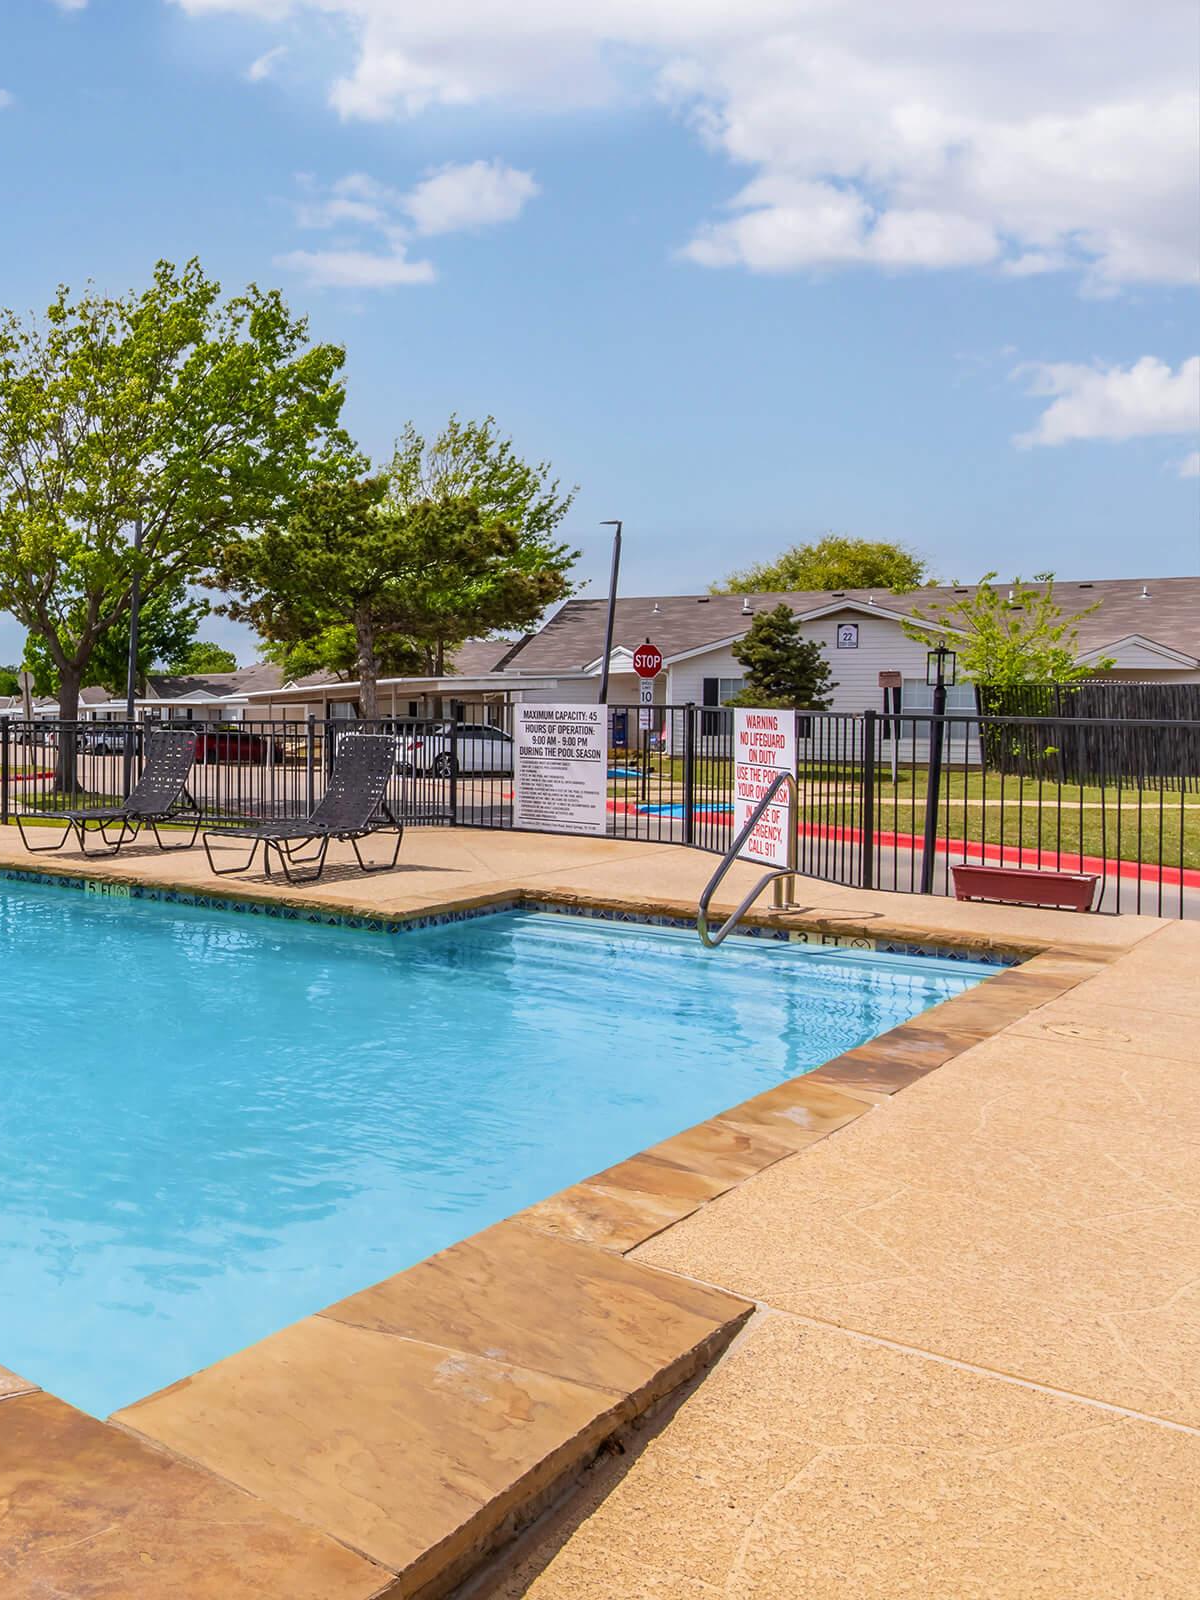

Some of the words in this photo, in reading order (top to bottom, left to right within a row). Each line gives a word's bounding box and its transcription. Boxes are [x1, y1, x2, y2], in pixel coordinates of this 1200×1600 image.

[843, 632, 853, 641] 22
[635, 654, 660, 668] STOP
[641, 691, 652, 702] 10
[523, 710, 554, 720] MAXIMUM
[555, 711, 587, 721] CAPACITY:
[589, 712, 597, 721] 45
[746, 715, 778, 730] WARNING
[525, 724, 546, 734] HOURS
[547, 724, 556, 734] OF
[557, 725, 595, 735] OPERATION:
[532, 736, 545, 745] 9:00
[547, 736, 556, 745] AM
[562, 737, 576, 746] 9:00
[577, 737, 588, 746] PM
[740, 731, 749, 745] NO
[750, 732, 785, 749] LIFEGUARD
[520, 746, 543, 756] DURING
[544, 747, 557, 757] THE
[558, 748, 574, 758] POOL
[576, 749, 601, 759] SEASON
[749, 748, 757, 762] ON
[759, 749, 776, 765] DUTY
[737, 766, 748, 780] USE
[750, 767, 761, 782] THE
[738, 782, 754, 799] YOUR
[772, 809, 780, 824] OF
[748, 838, 764, 855] CALL
[765, 842, 775, 857] 911
[822, 935, 842, 946] FT
